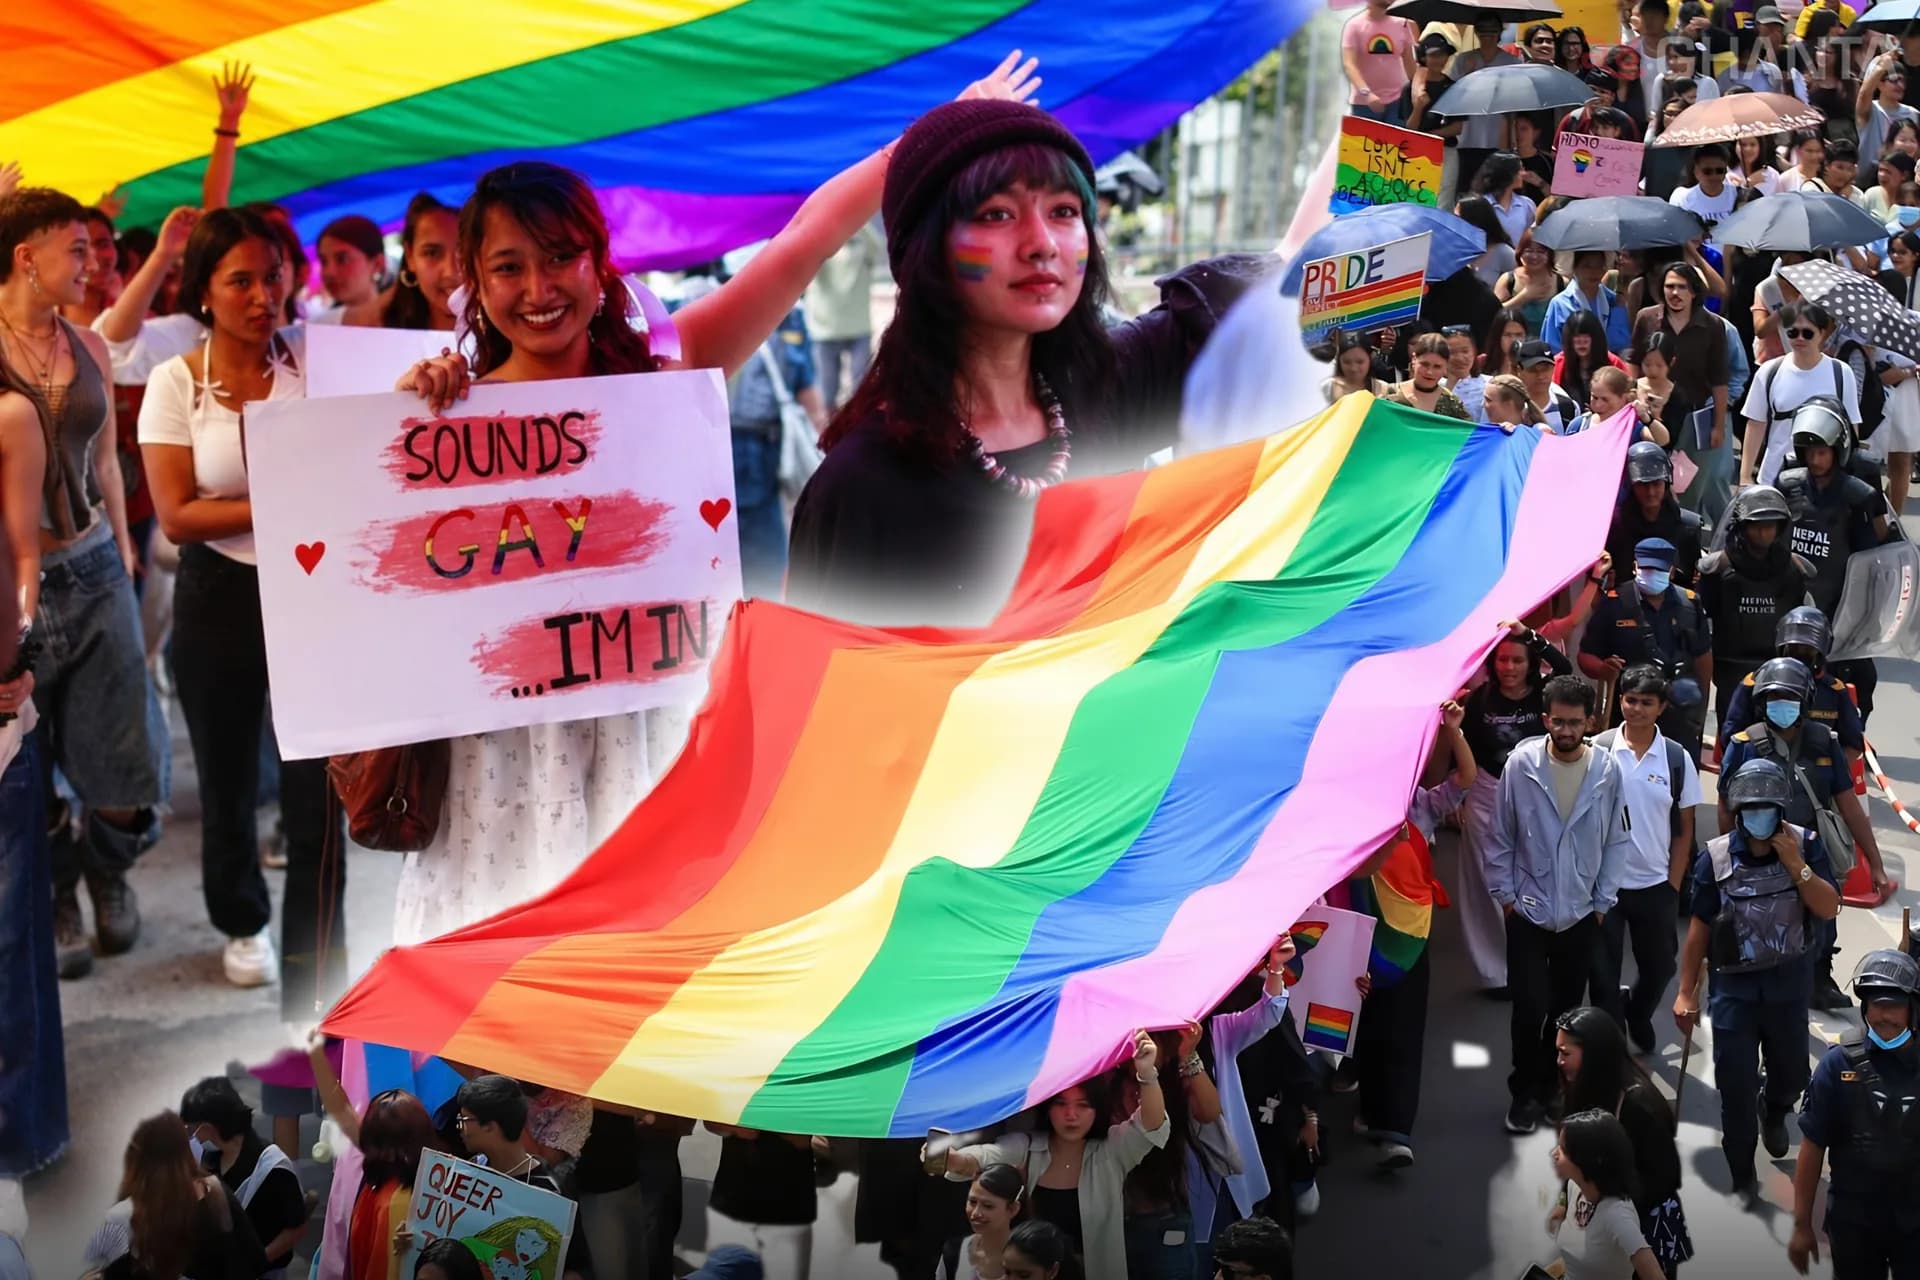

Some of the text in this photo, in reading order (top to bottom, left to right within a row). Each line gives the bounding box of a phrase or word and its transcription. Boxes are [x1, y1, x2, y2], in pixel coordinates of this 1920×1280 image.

[1363, 136, 1408, 161] LOVE
[1303, 249, 1385, 303] PRIDE
[403, 411, 588, 483] SOUNDS
[424, 499, 593, 579] GAY
[1791, 539, 1830, 558] POLICE
[1792, 526, 1830, 545] NEPAL
[1739, 605, 1776, 614] POLICE
[1741, 597, 1775, 606] NEPAL
[646, 601, 708, 670] IN
[428, 1162, 504, 1216] QUEER
[416, 1192, 467, 1237] JOY
